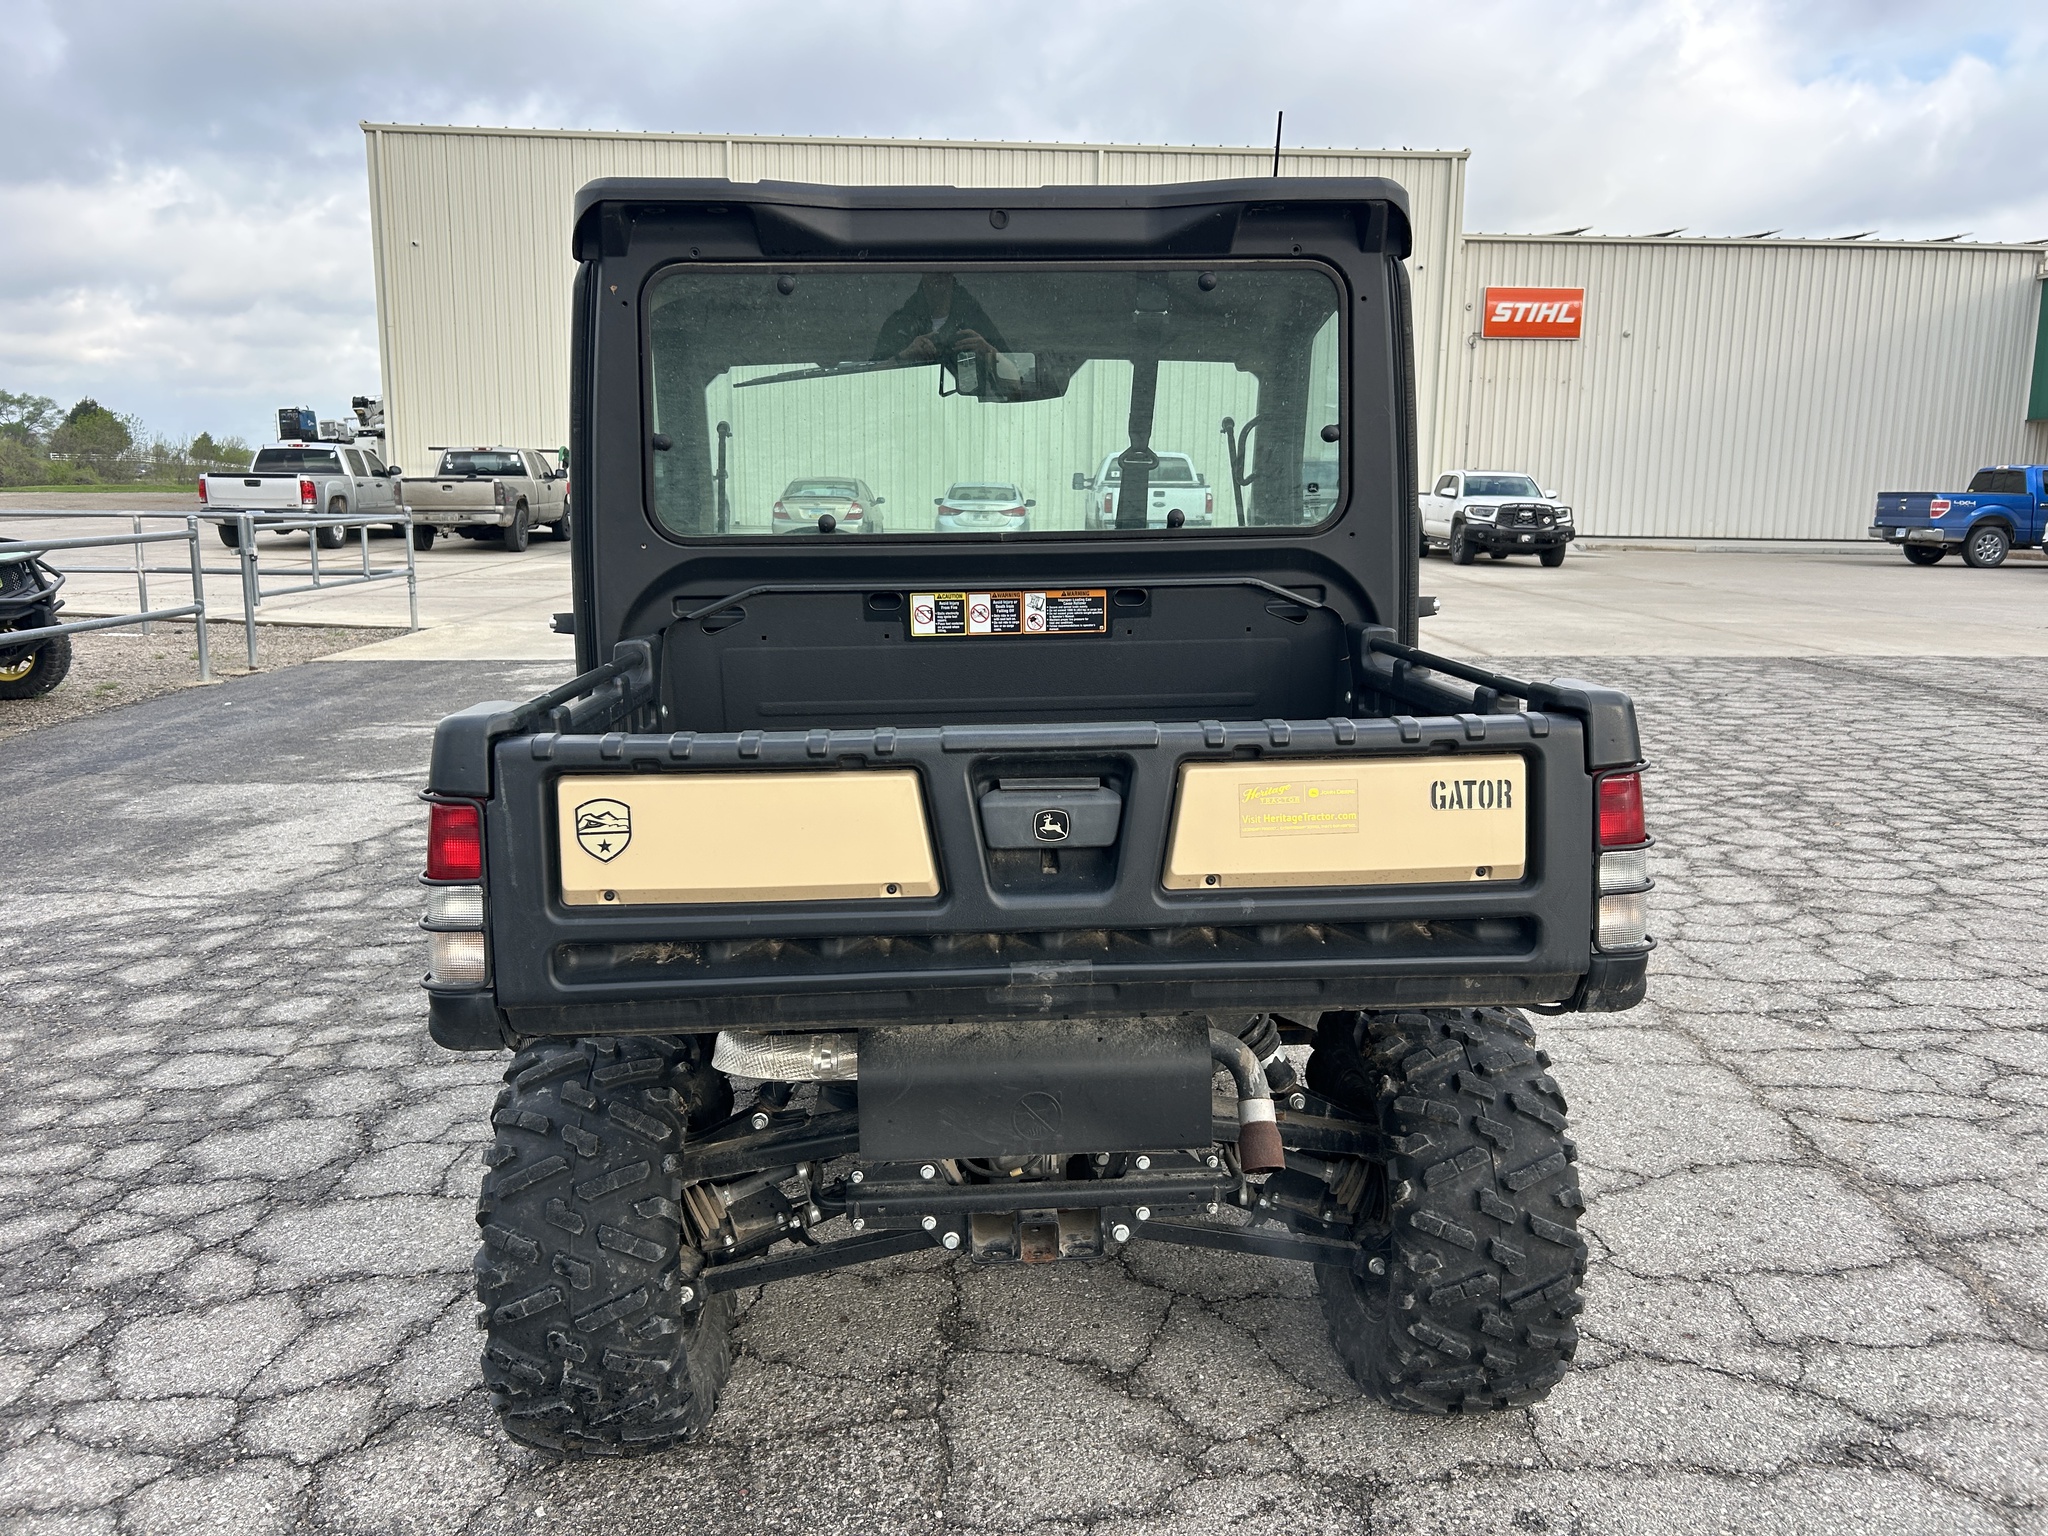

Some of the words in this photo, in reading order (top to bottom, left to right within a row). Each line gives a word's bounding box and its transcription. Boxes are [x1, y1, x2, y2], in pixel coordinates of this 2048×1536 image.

[1490, 301, 1575, 323] STIHL
[1241, 784, 1292, 803] Heritage
[1260, 796, 1300, 805] TRACTOR
[1431, 779, 1512, 809] GATOR
[1241, 814, 1262, 824] Visit
[1263, 812, 1357, 824] HeritageTractor.com
